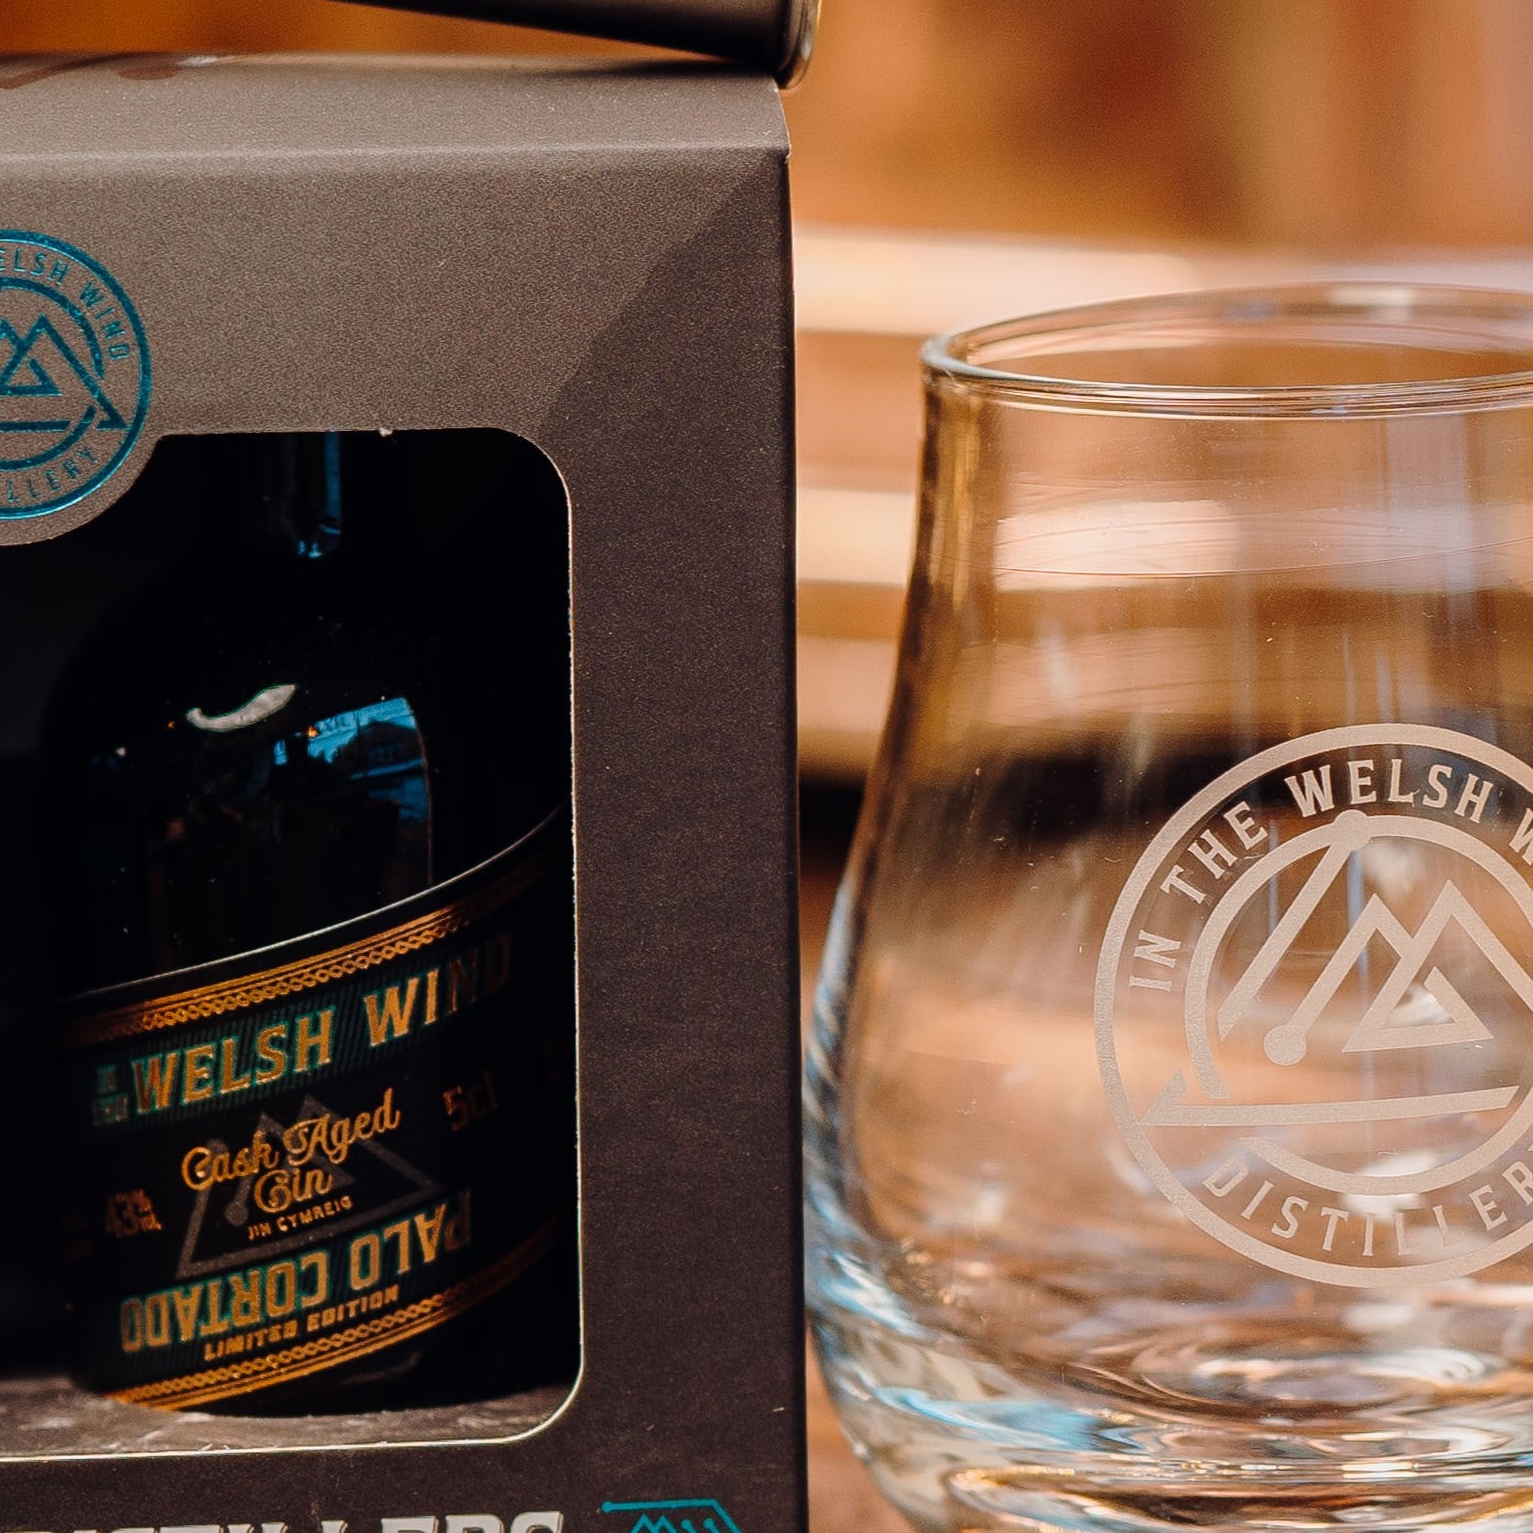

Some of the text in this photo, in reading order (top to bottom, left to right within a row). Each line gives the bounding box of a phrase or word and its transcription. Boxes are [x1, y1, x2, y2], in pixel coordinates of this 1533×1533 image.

[78, 281, 130, 360] WIND
[1129, 929, 1182, 992] IN
[1161, 801, 1268, 905] THE
[1284, 758, 1494, 823] WELSH
[132, 1004, 337, 1115] WELSH
[181, 1087, 403, 1192] Cask Aged
[246, 1194, 356, 1242] JIN CYMREIG
[253, 1166, 334, 1215] Gin
[120, 1189, 471, 1355] PALO CORTADO
[203, 1283, 401, 1362] LIMITED EDITION
